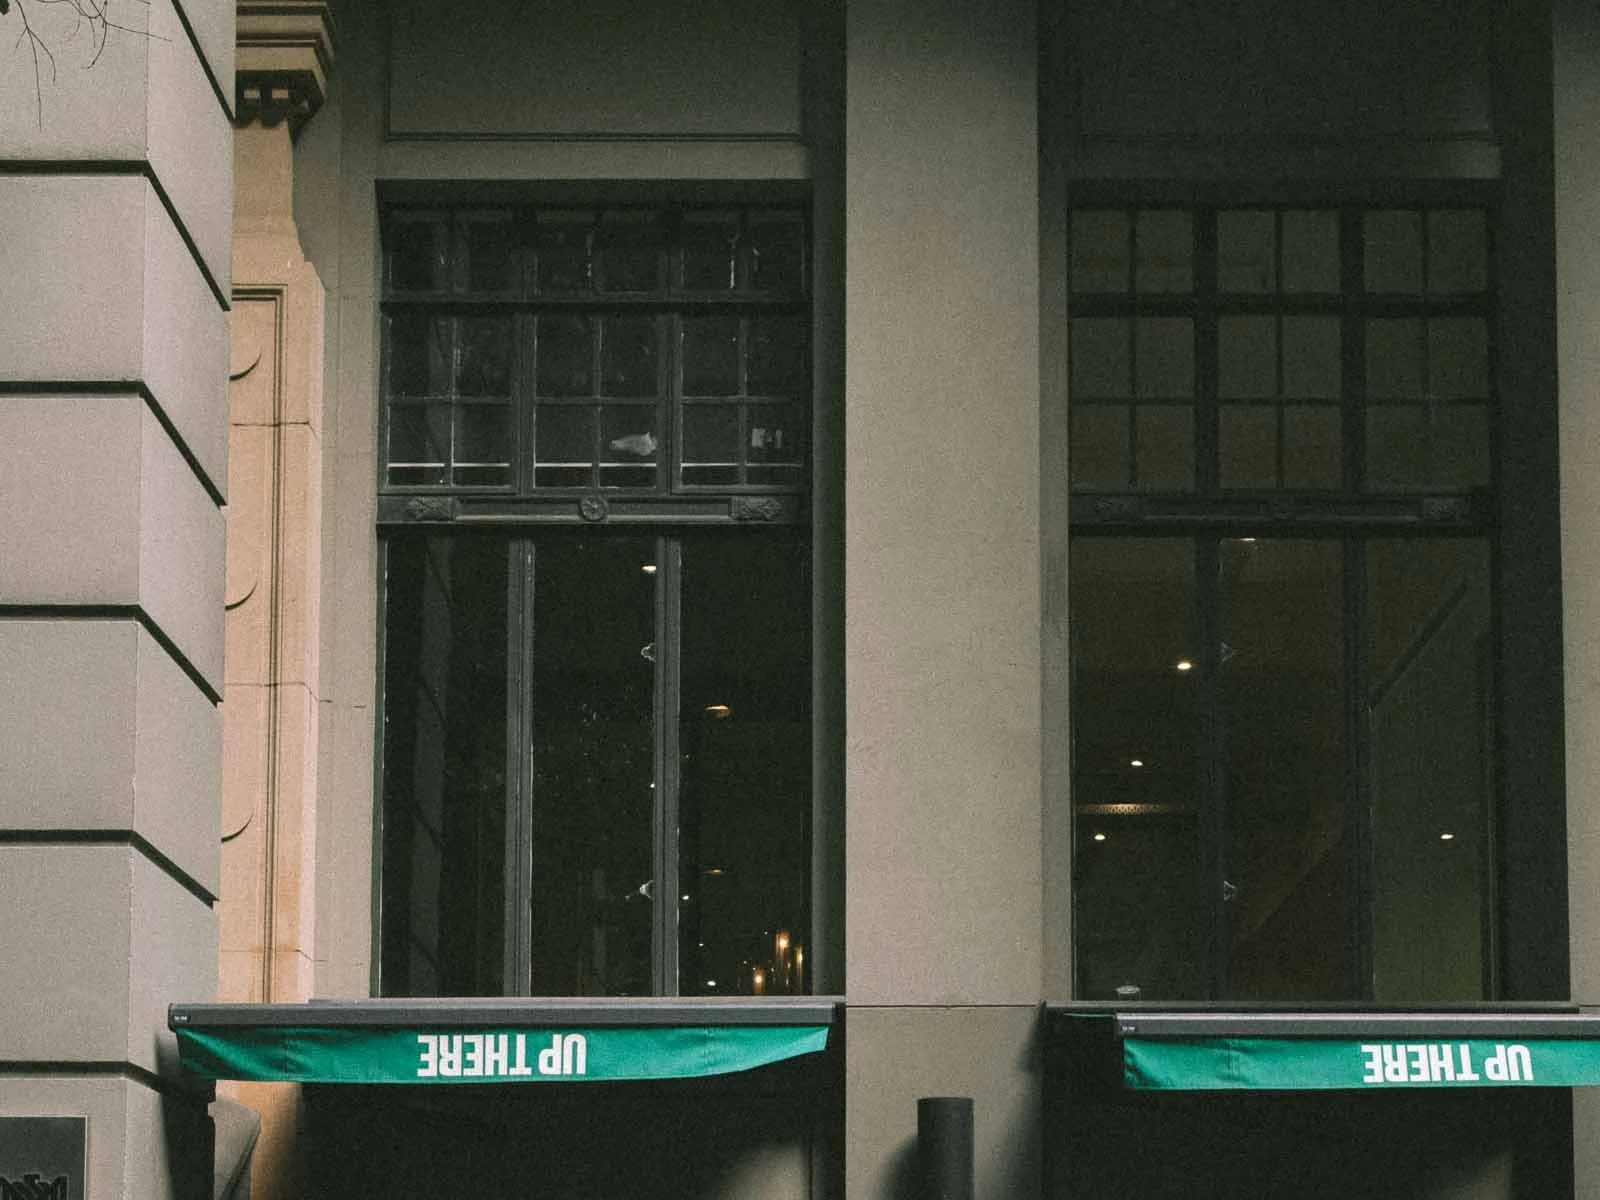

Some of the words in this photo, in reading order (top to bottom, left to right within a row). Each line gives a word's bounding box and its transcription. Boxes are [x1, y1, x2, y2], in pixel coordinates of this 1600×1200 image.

[416, 1034, 532, 1077] THERE
[538, 1033, 587, 1075] UP
[1360, 1044, 1480, 1083] THERE
[1484, 1044, 1534, 1081] UP
